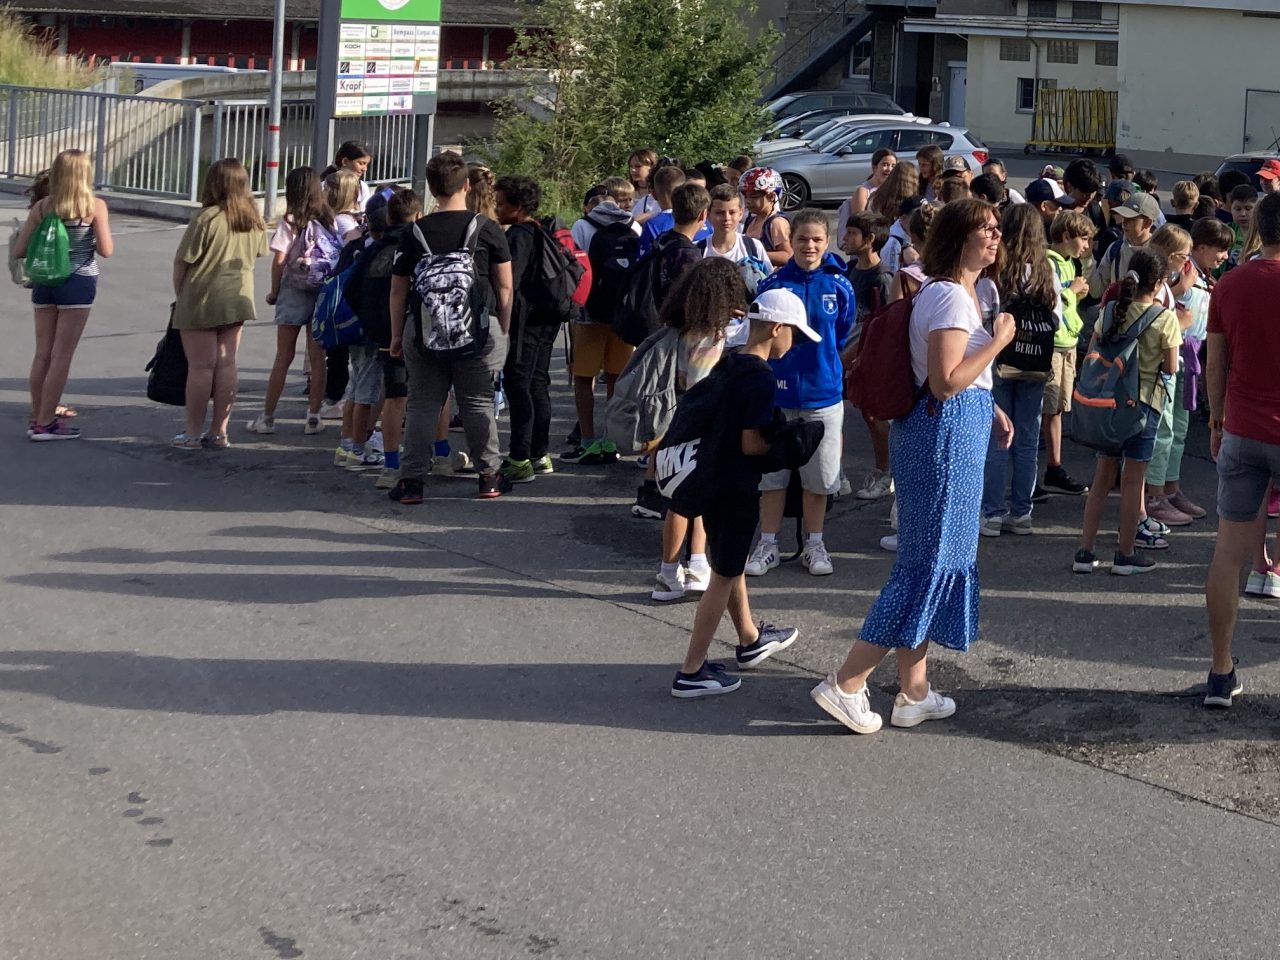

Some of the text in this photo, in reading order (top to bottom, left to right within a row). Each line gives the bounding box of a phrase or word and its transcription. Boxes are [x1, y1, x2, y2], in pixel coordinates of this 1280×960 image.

[340, 80, 362, 92] Krapf
[1015, 341, 1042, 356] BERLIN
[656, 438, 701, 480] NIKE
